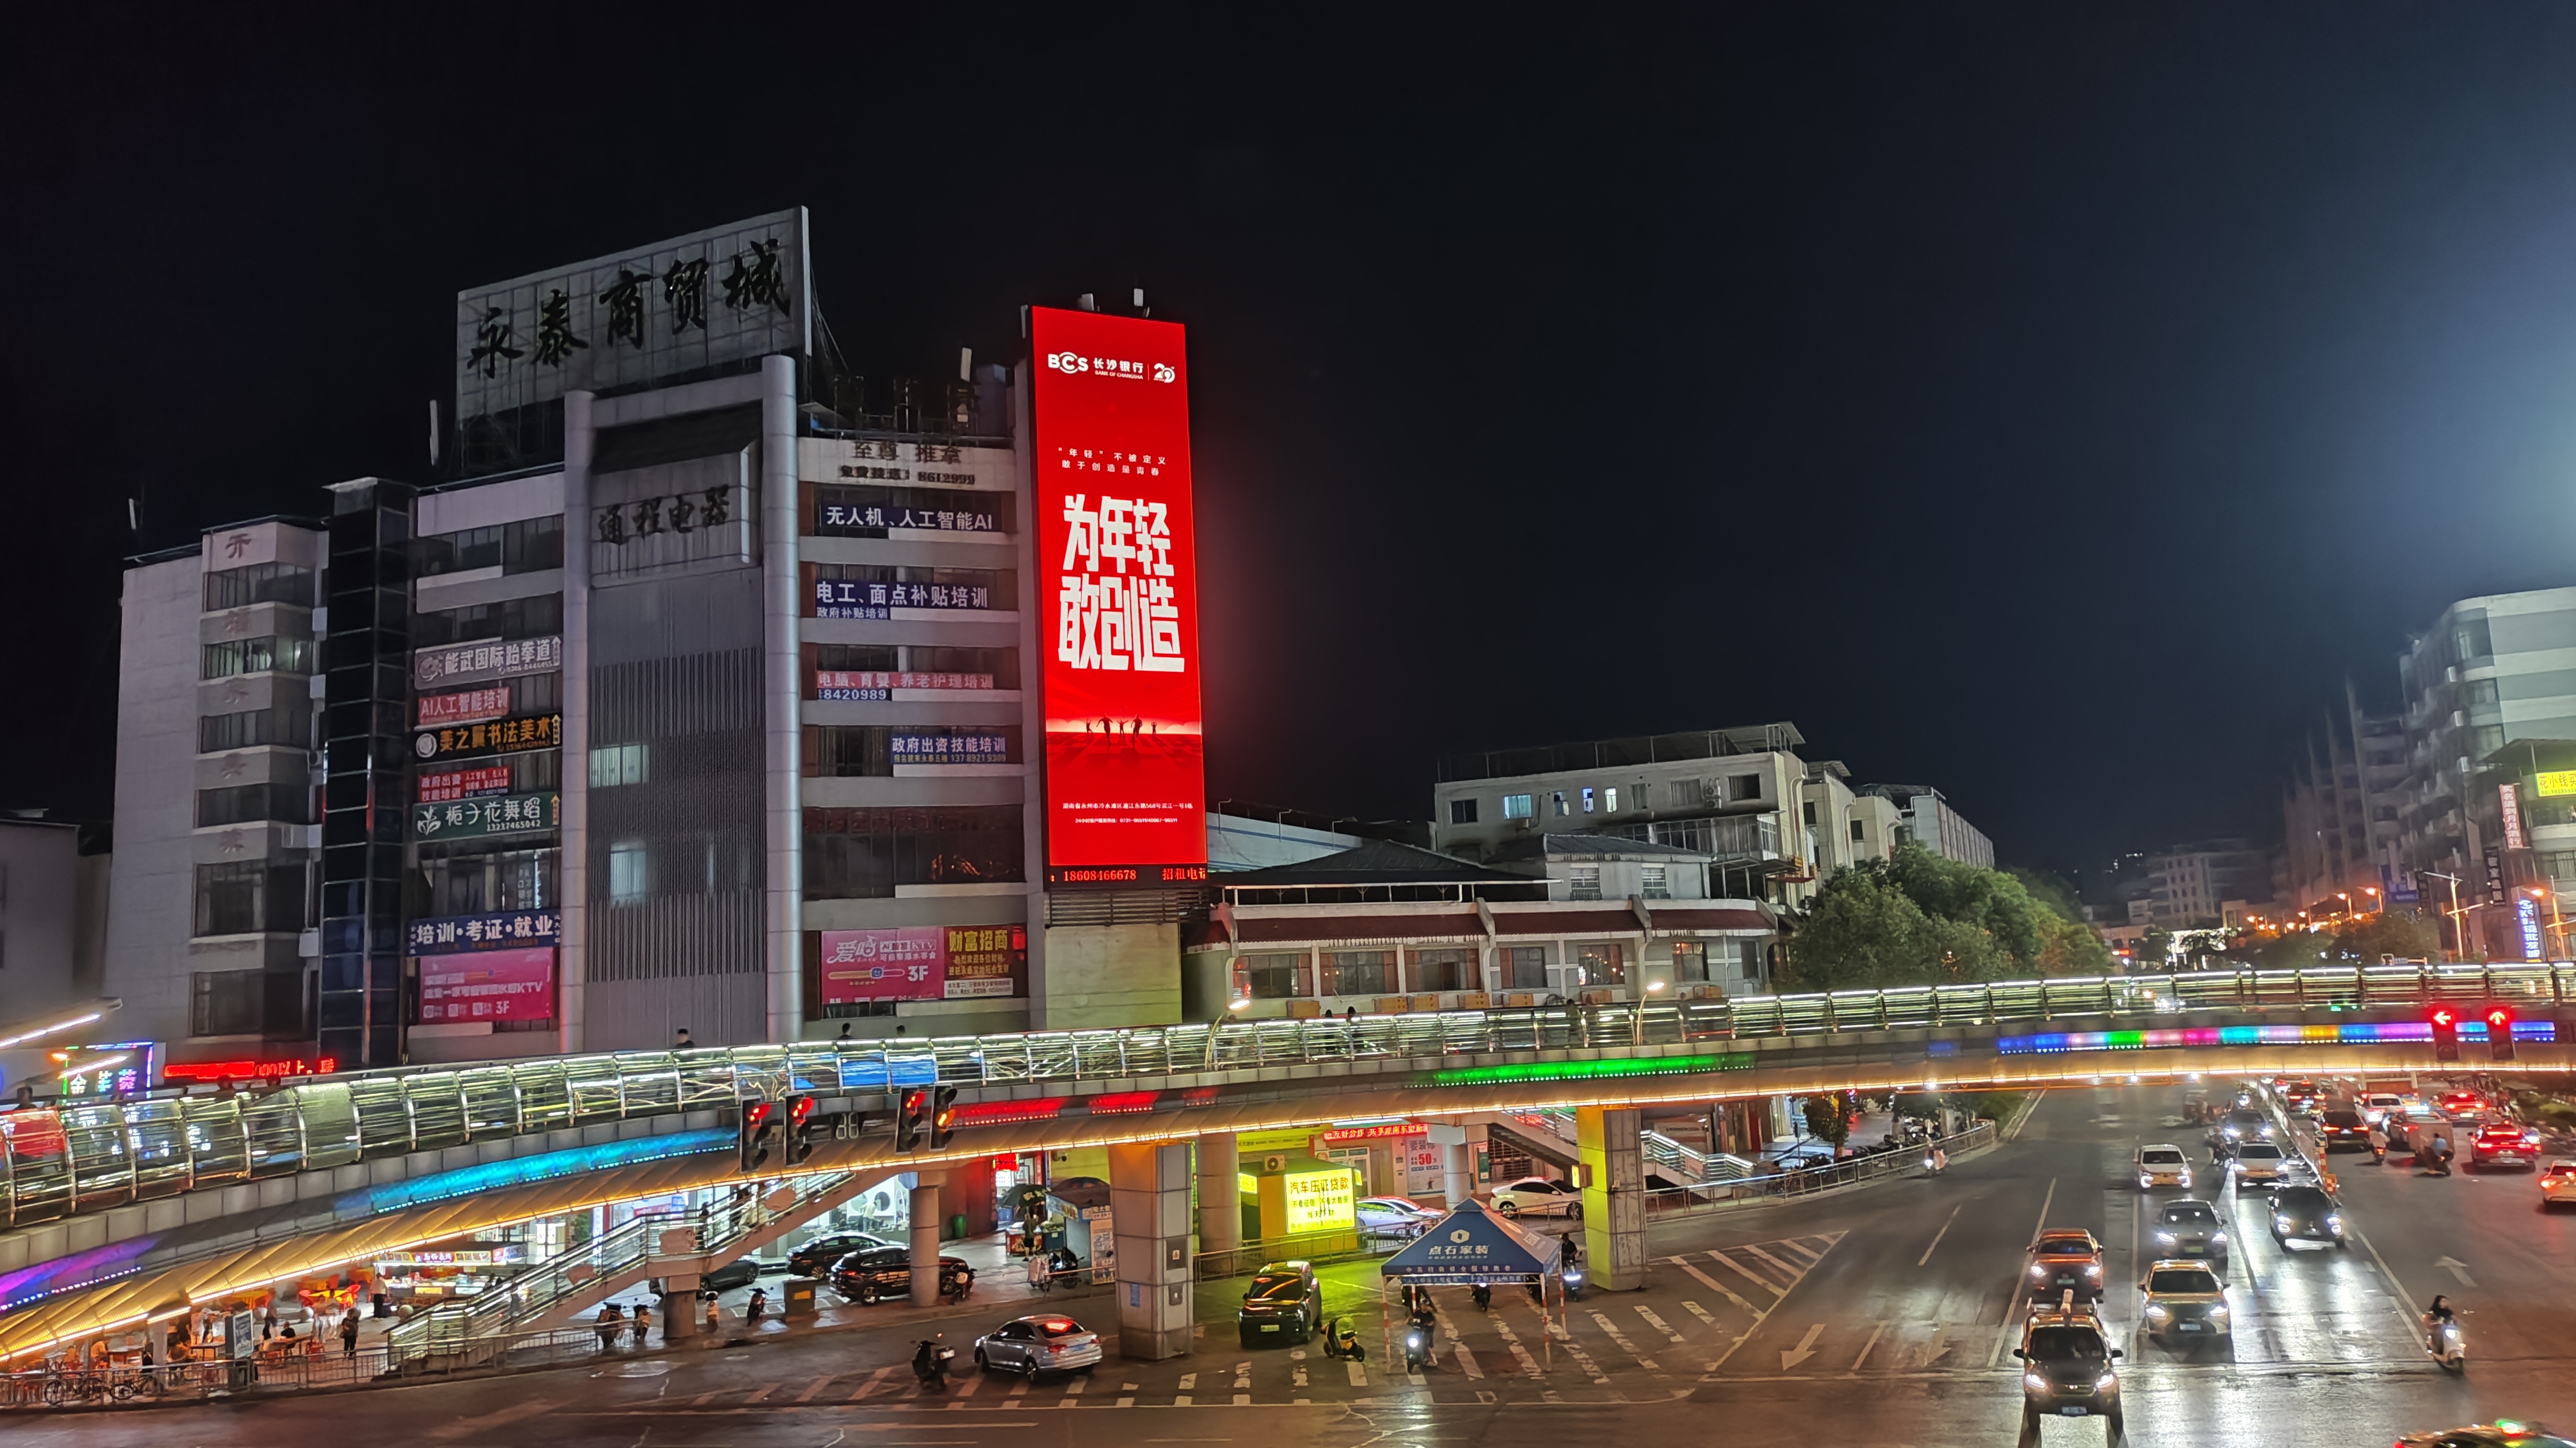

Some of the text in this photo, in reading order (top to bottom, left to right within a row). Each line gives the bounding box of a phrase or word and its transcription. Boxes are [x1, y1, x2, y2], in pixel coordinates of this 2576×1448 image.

[467, 238, 790, 379] 永泰商贸城
[1048, 351, 1089, 374] BCS
[1093, 358, 1143, 373] 长沙银行
[1062, 460, 1159, 476] 敢于创造是青春
[827, 506, 992, 530] 无人机、人工智能AI
[1062, 493, 1174, 576] 为年轻
[817, 581, 988, 608] 电工、面点补贴培训
[817, 607, 888, 619] 政府补贴培训
[1058, 573, 1184, 672] 敢创造
[2538, 773, 2576, 789] 花小钱买
[446, 797, 540, 826] 栀子花舞蹈
[949, 930, 1007, 952] 财富招商
[908, 965, 929, 981] 3F
[496, 1001, 510, 1014] 3F
[1428, 1245, 1489, 1255] 点石家装
